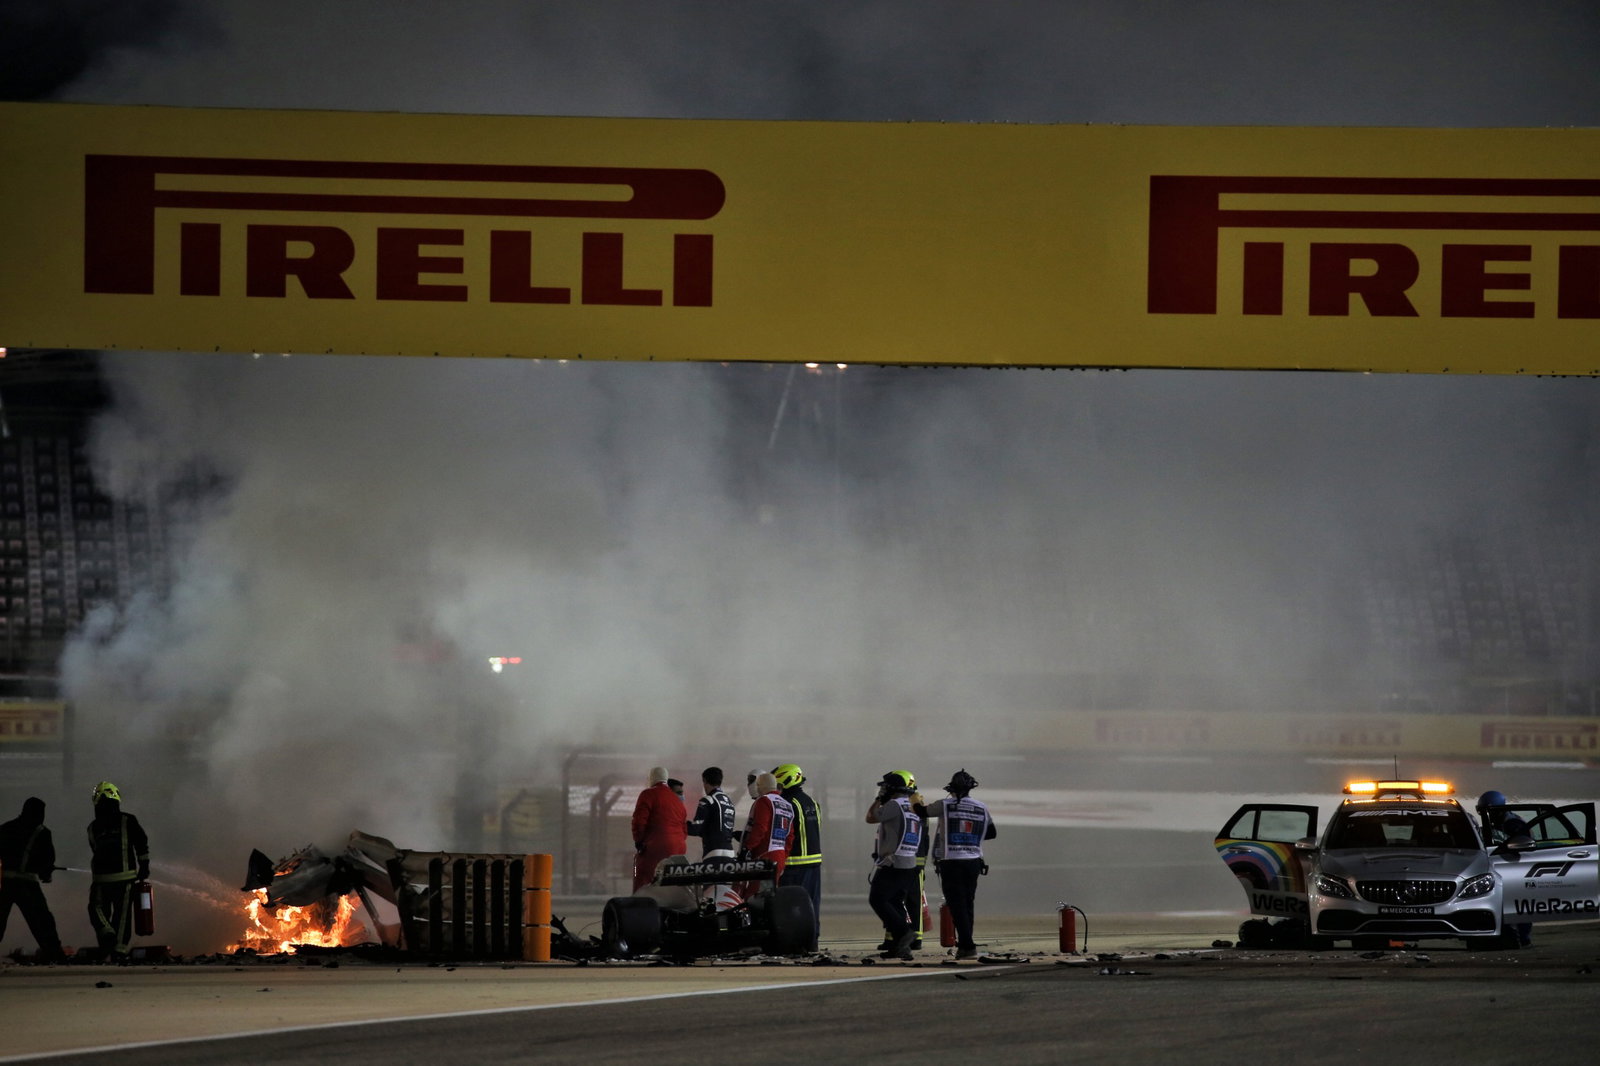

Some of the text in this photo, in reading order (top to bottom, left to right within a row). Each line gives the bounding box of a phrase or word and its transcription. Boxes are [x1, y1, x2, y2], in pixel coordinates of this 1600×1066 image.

[84, 154, 726, 307] PIRELLI
[1480, 722, 1598, 749] PIRELLI
[1514, 897, 1600, 916] WeRace
